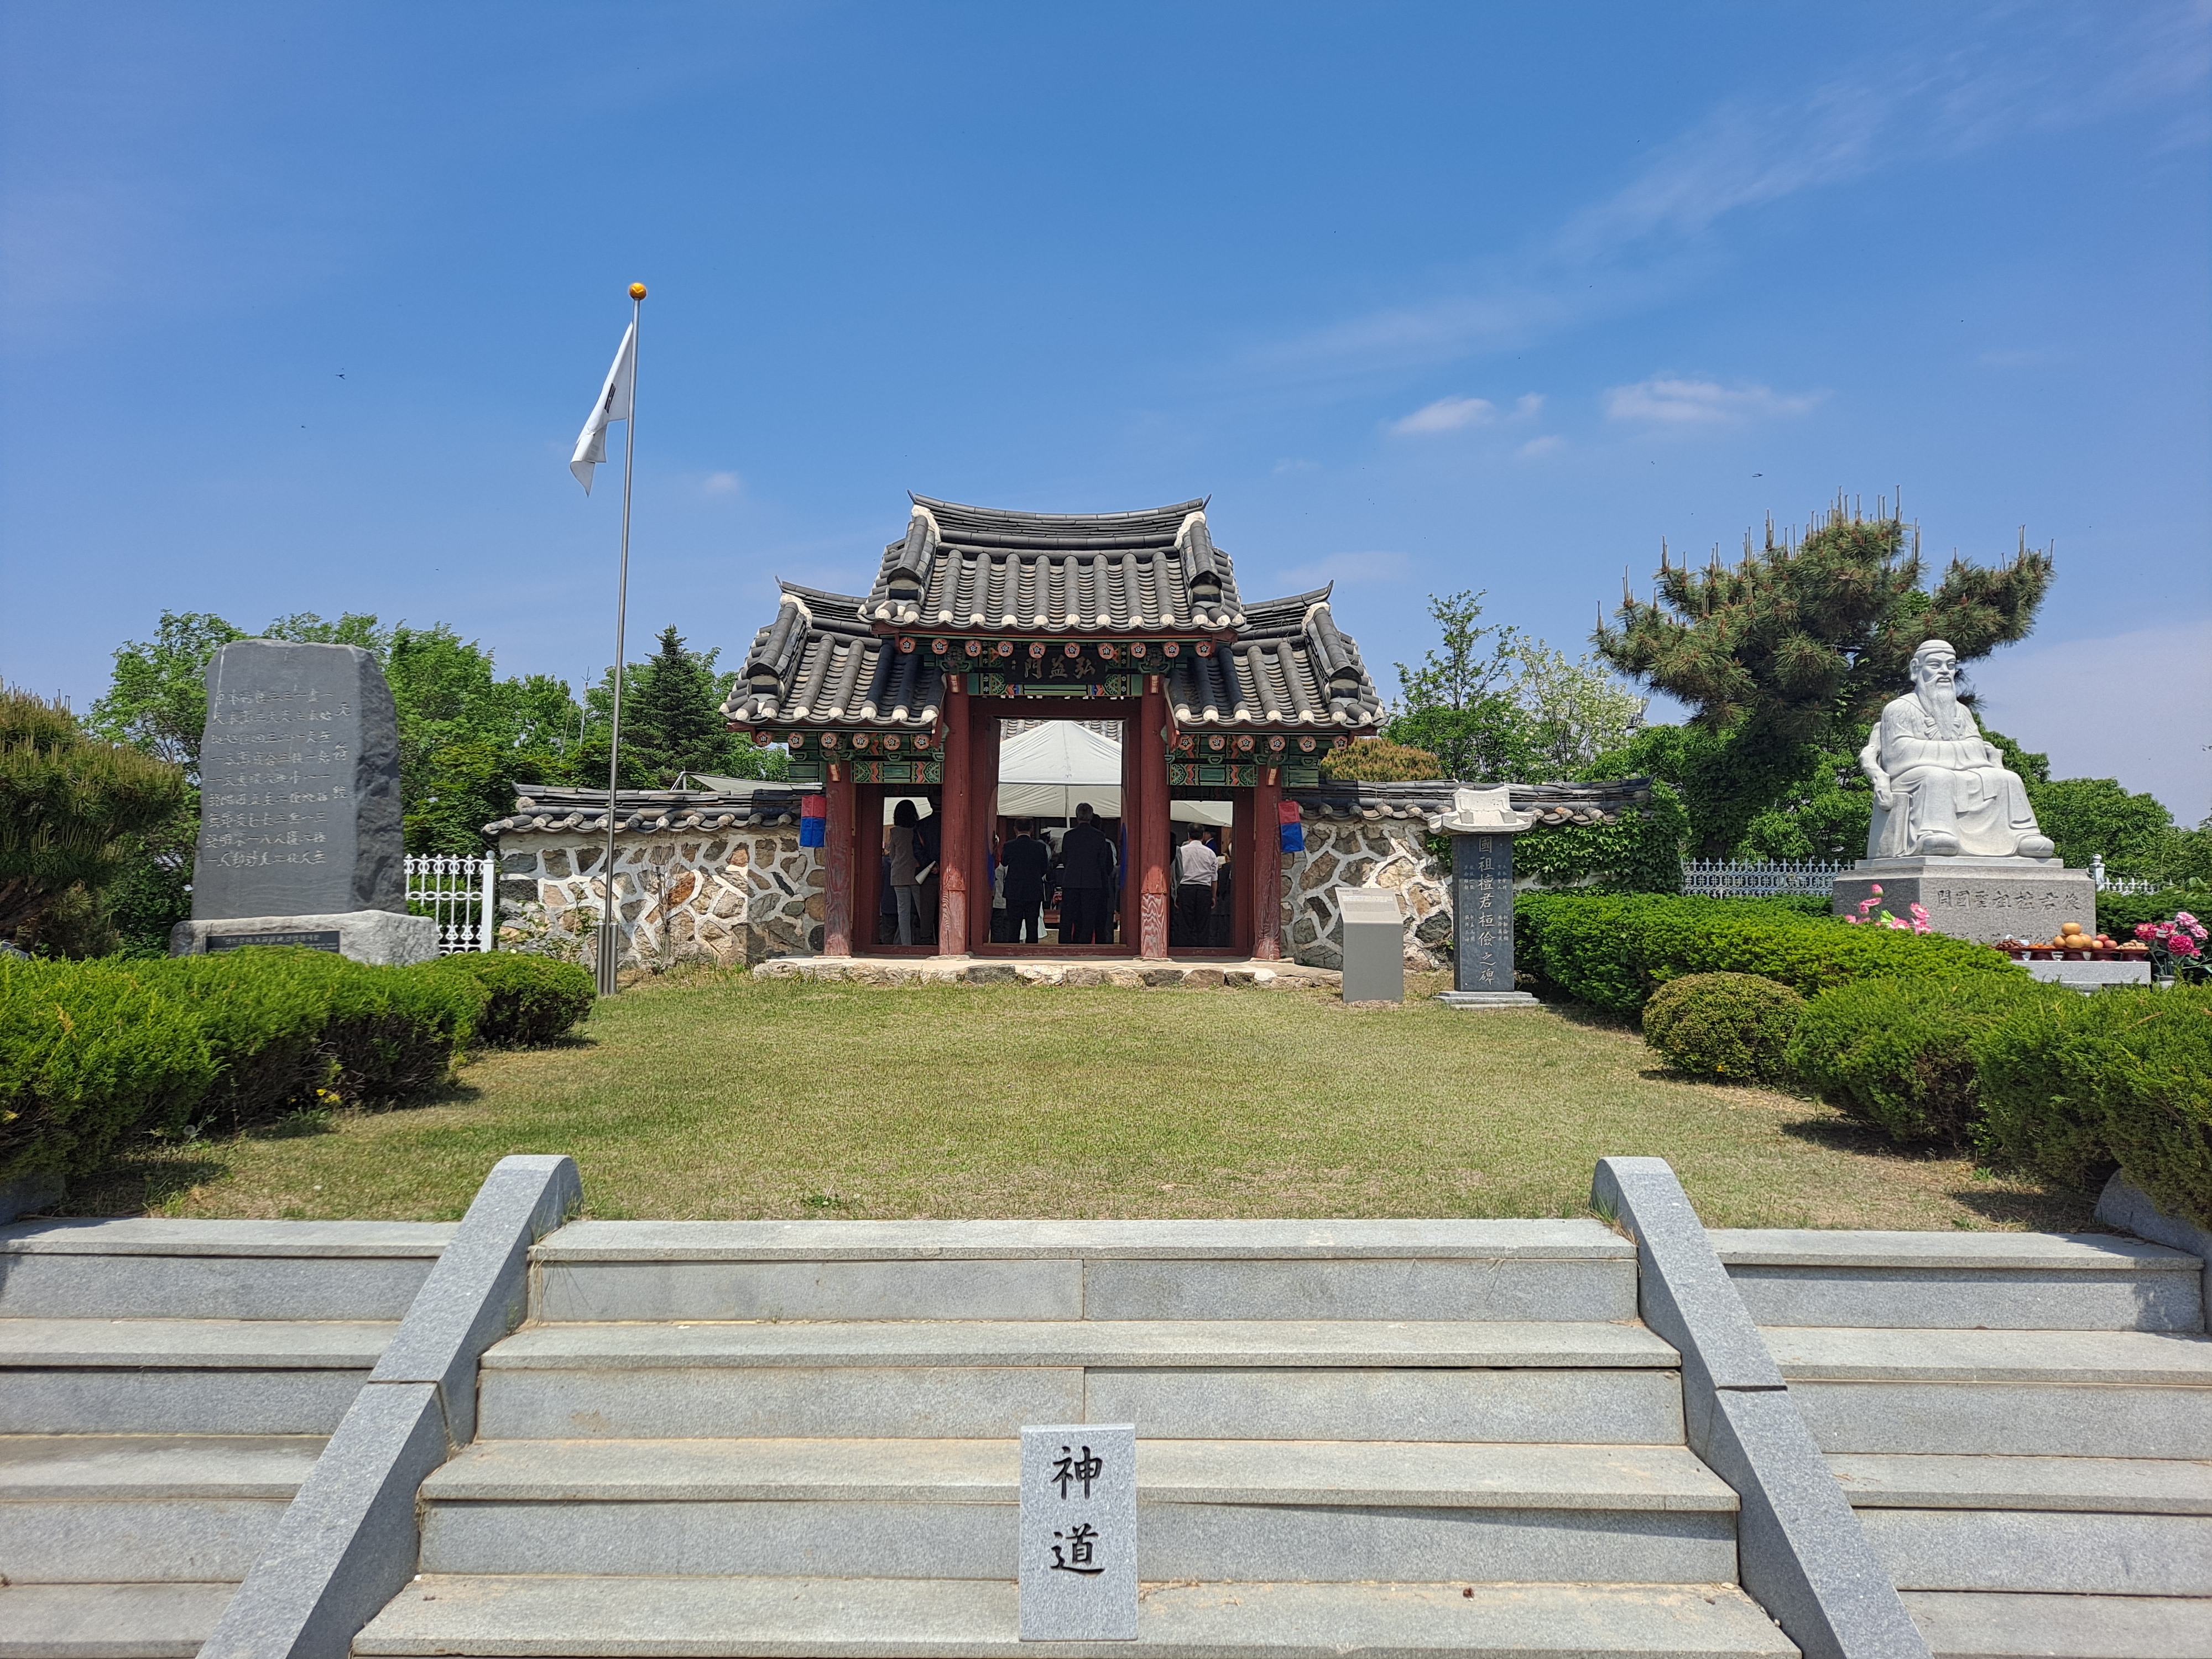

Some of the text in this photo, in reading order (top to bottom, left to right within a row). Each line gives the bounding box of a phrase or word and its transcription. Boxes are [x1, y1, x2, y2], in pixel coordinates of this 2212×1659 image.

[1024, 654, 1095, 679] 弘益門
[1051, 1446, 1105, 1575] 神道
